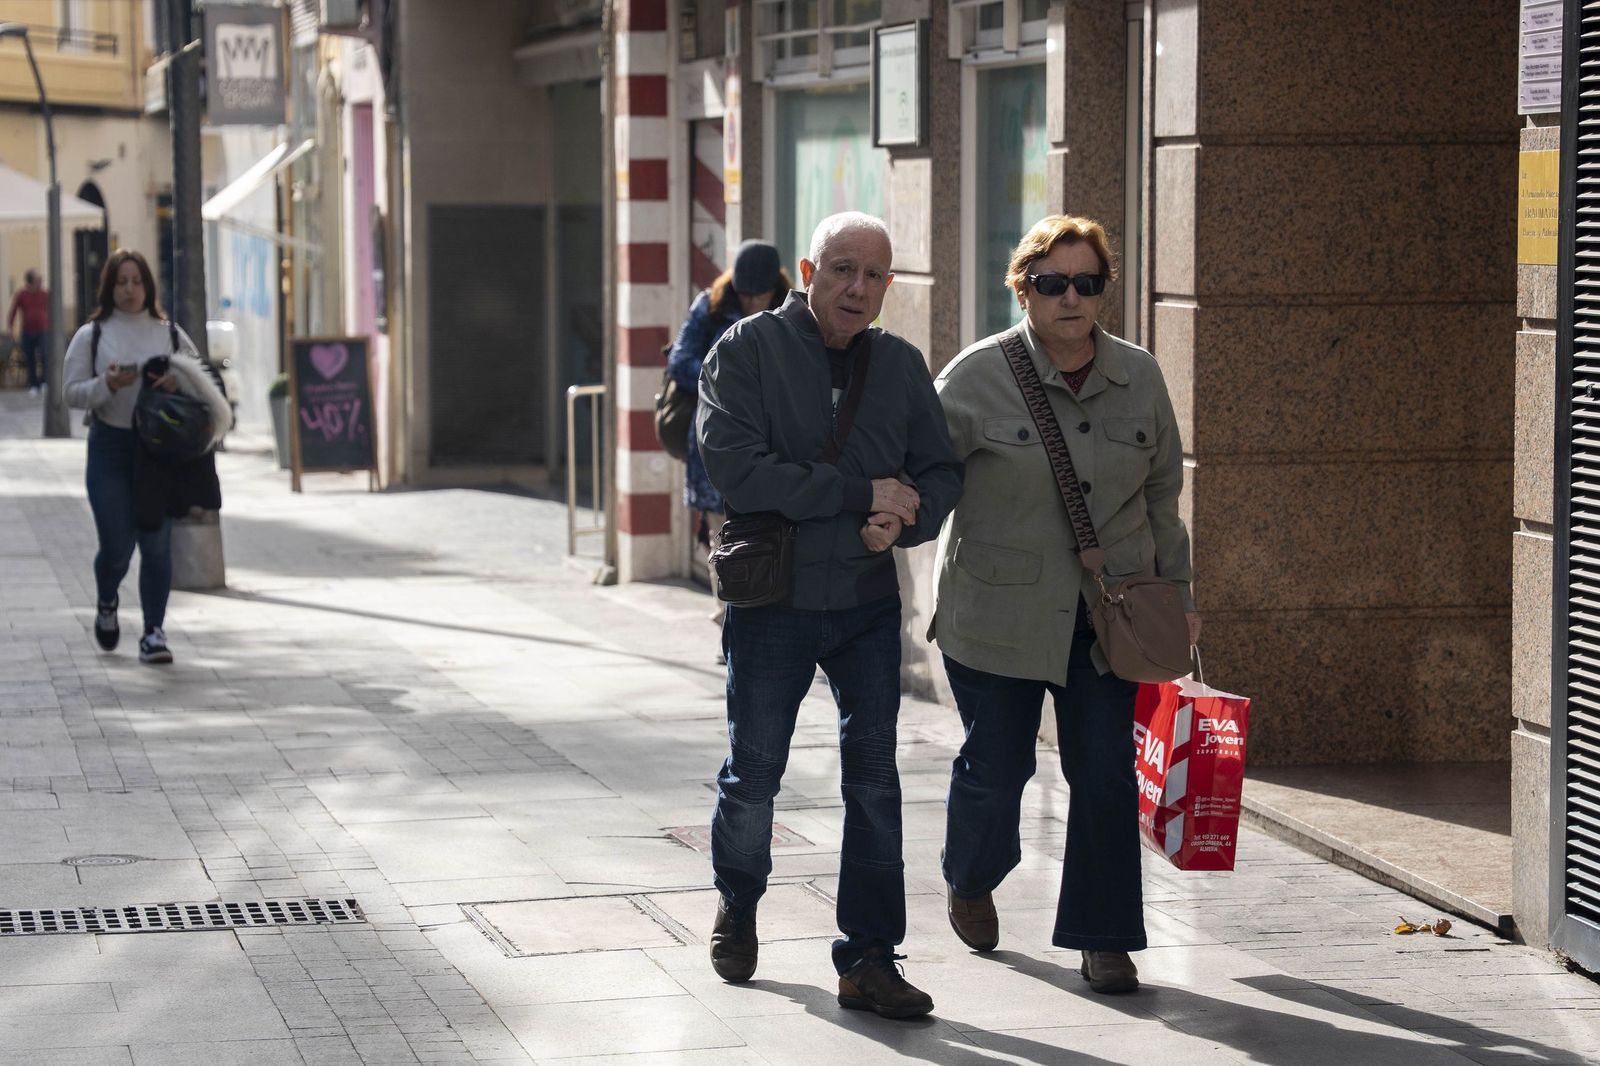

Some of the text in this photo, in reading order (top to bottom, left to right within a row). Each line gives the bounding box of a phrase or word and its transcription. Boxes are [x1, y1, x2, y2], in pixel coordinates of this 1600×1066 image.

[300, 398, 365, 441] 40%
[1198, 718, 1240, 733] EVA
[1200, 733, 1244, 747] joven
[1134, 760, 1163, 807] oven
